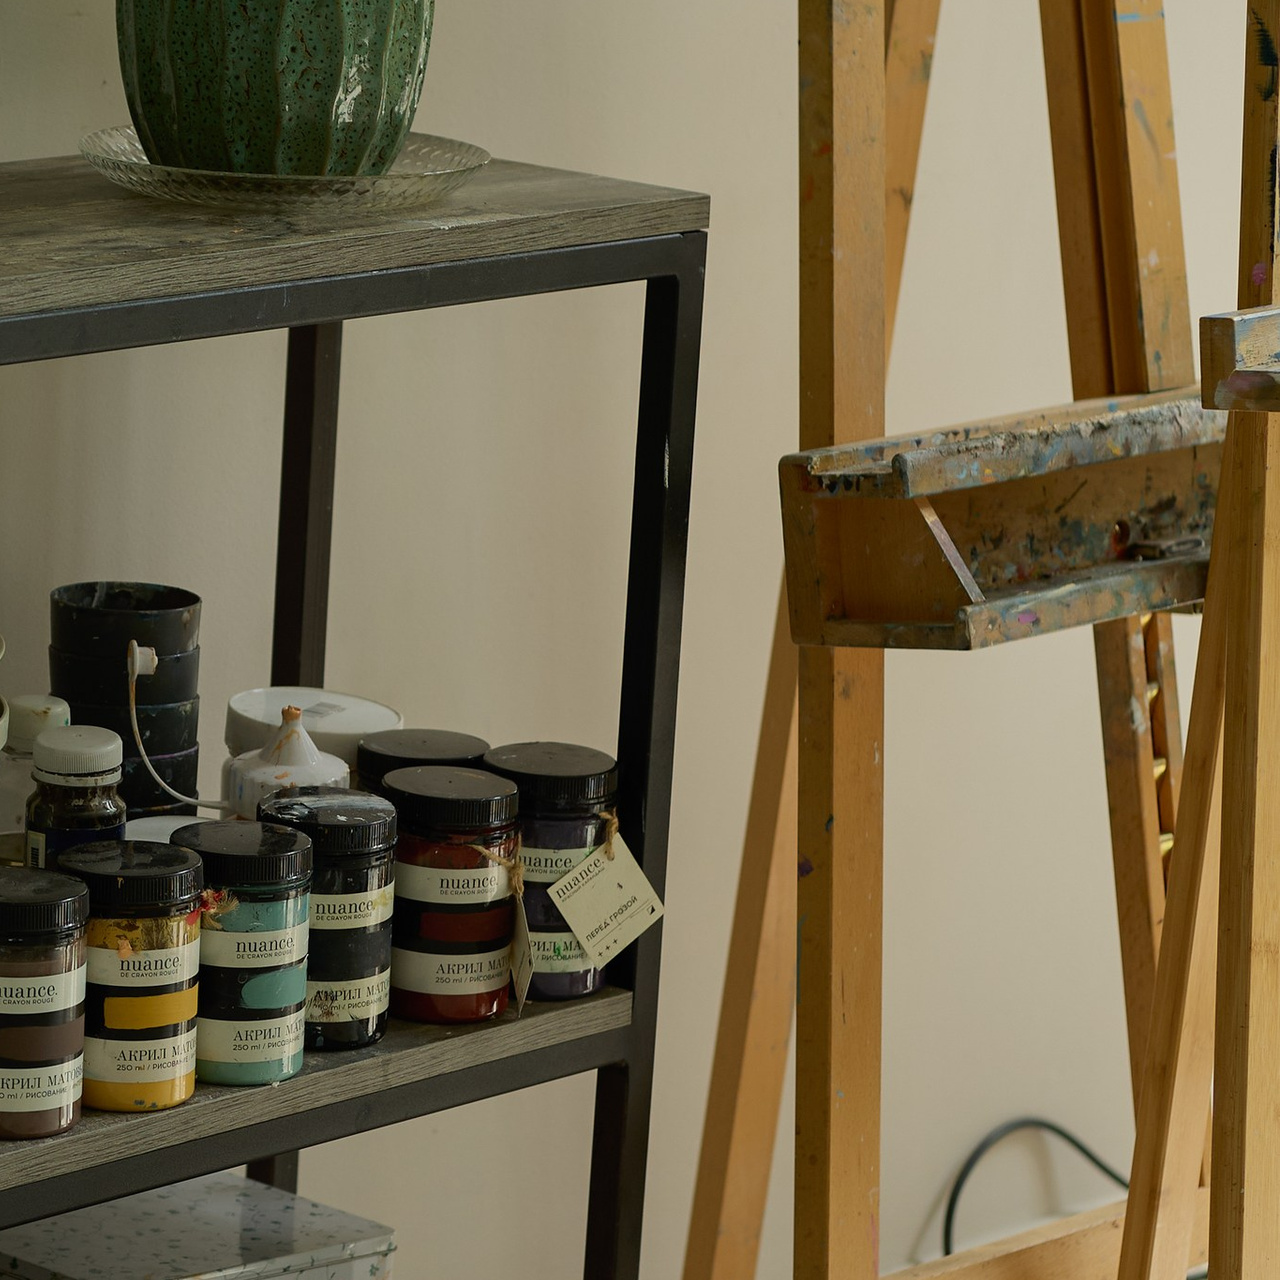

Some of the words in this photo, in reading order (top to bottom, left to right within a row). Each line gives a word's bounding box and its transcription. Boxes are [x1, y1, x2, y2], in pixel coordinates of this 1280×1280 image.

[440, 876, 498, 889] nuance.
[556, 858, 604, 898] nuance.
[316, 900, 375, 914] nuance.
[586, 920, 610, 942] ПЕРЕД
[609, 895, 638, 922] ГРОЗОЙ
[236, 937, 295, 952] nuance.
[530, 941, 556, 953] РИЛ
[120, 956, 181, 971] nuance.
[436, 962, 483, 974] АКРИЛ
[233, 1027, 281, 1041] АКРИЛ
[117, 1048, 166, 1062] АКРИЛ
